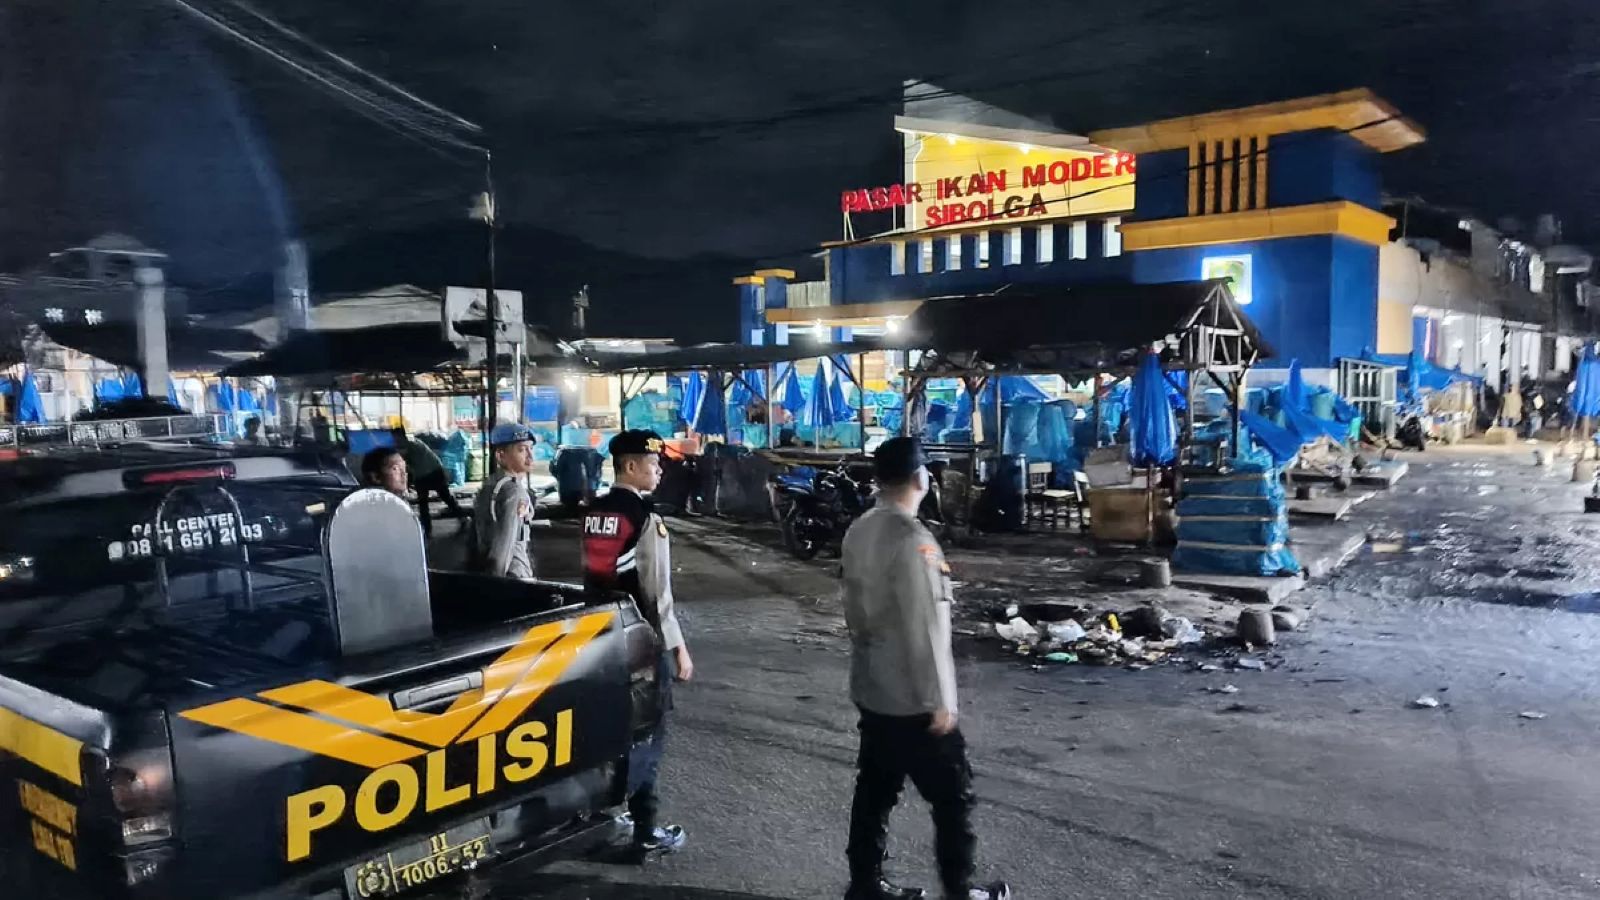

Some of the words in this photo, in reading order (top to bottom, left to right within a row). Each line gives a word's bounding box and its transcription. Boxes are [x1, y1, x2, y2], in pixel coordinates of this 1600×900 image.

[841, 181, 923, 213] PASAR
[936, 170, 1007, 201] IKAN
[926, 193, 1048, 228] SIBOLGA
[584, 516, 619, 535] POLISI
[127, 535, 173, 556] 081
[180, 531, 213, 549] 651
[286, 708, 573, 862] POLISI
[429, 832, 449, 853] II
